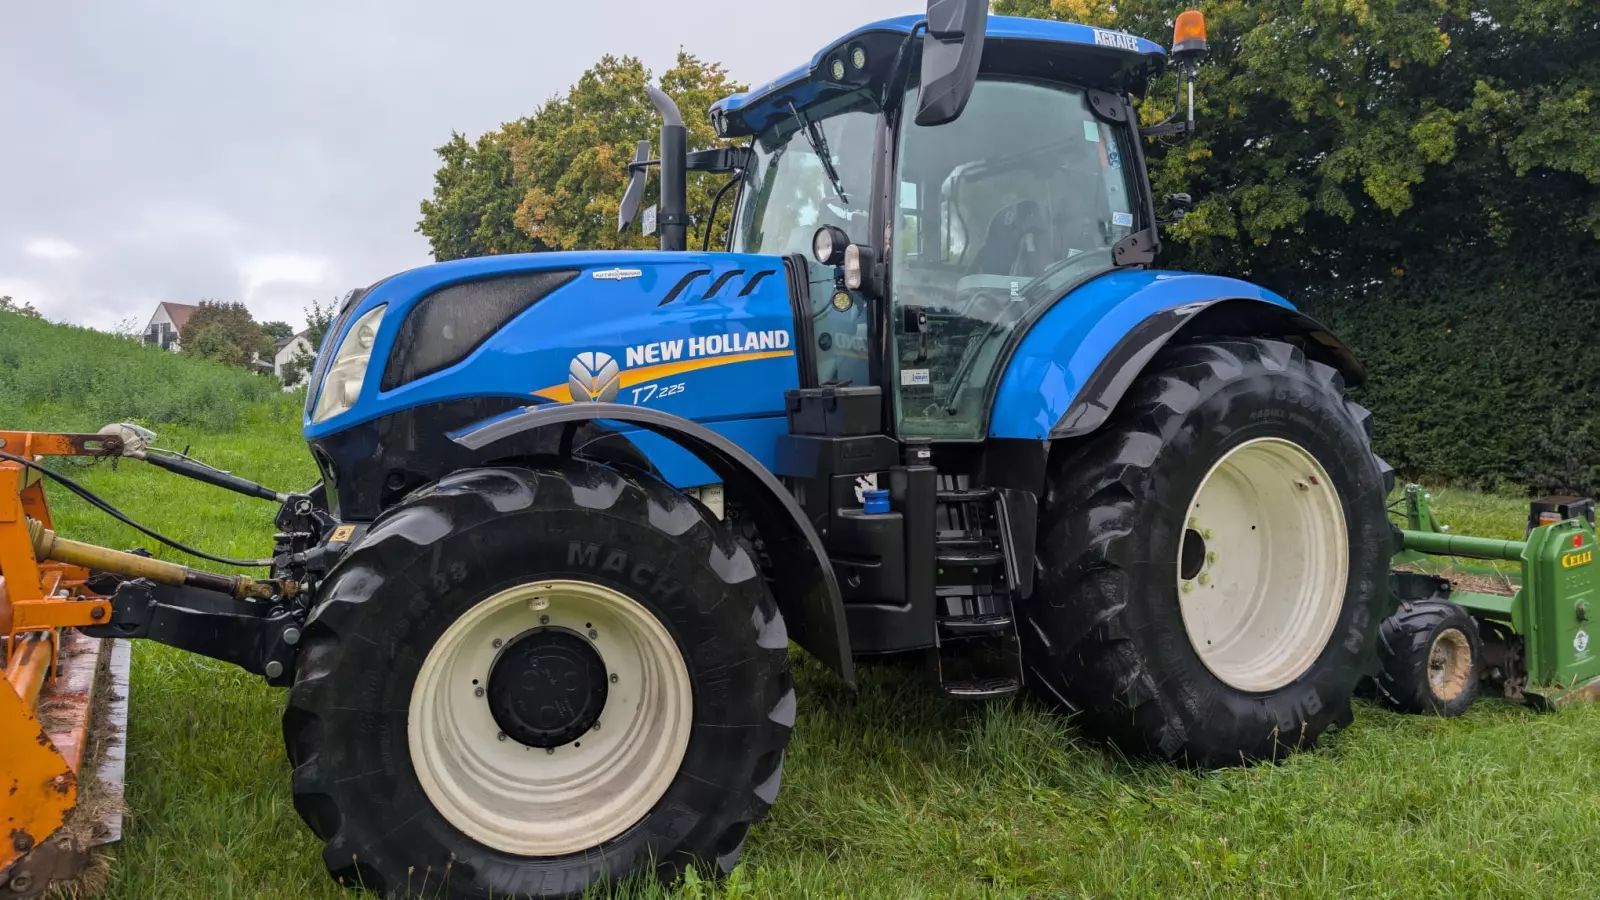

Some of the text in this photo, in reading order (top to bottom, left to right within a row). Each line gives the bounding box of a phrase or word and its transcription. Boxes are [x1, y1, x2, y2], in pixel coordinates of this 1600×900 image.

[626, 330, 789, 367] NEW HOLLAND
[631, 382, 685, 405] T7.225
[567, 541, 683, 597] MACH
